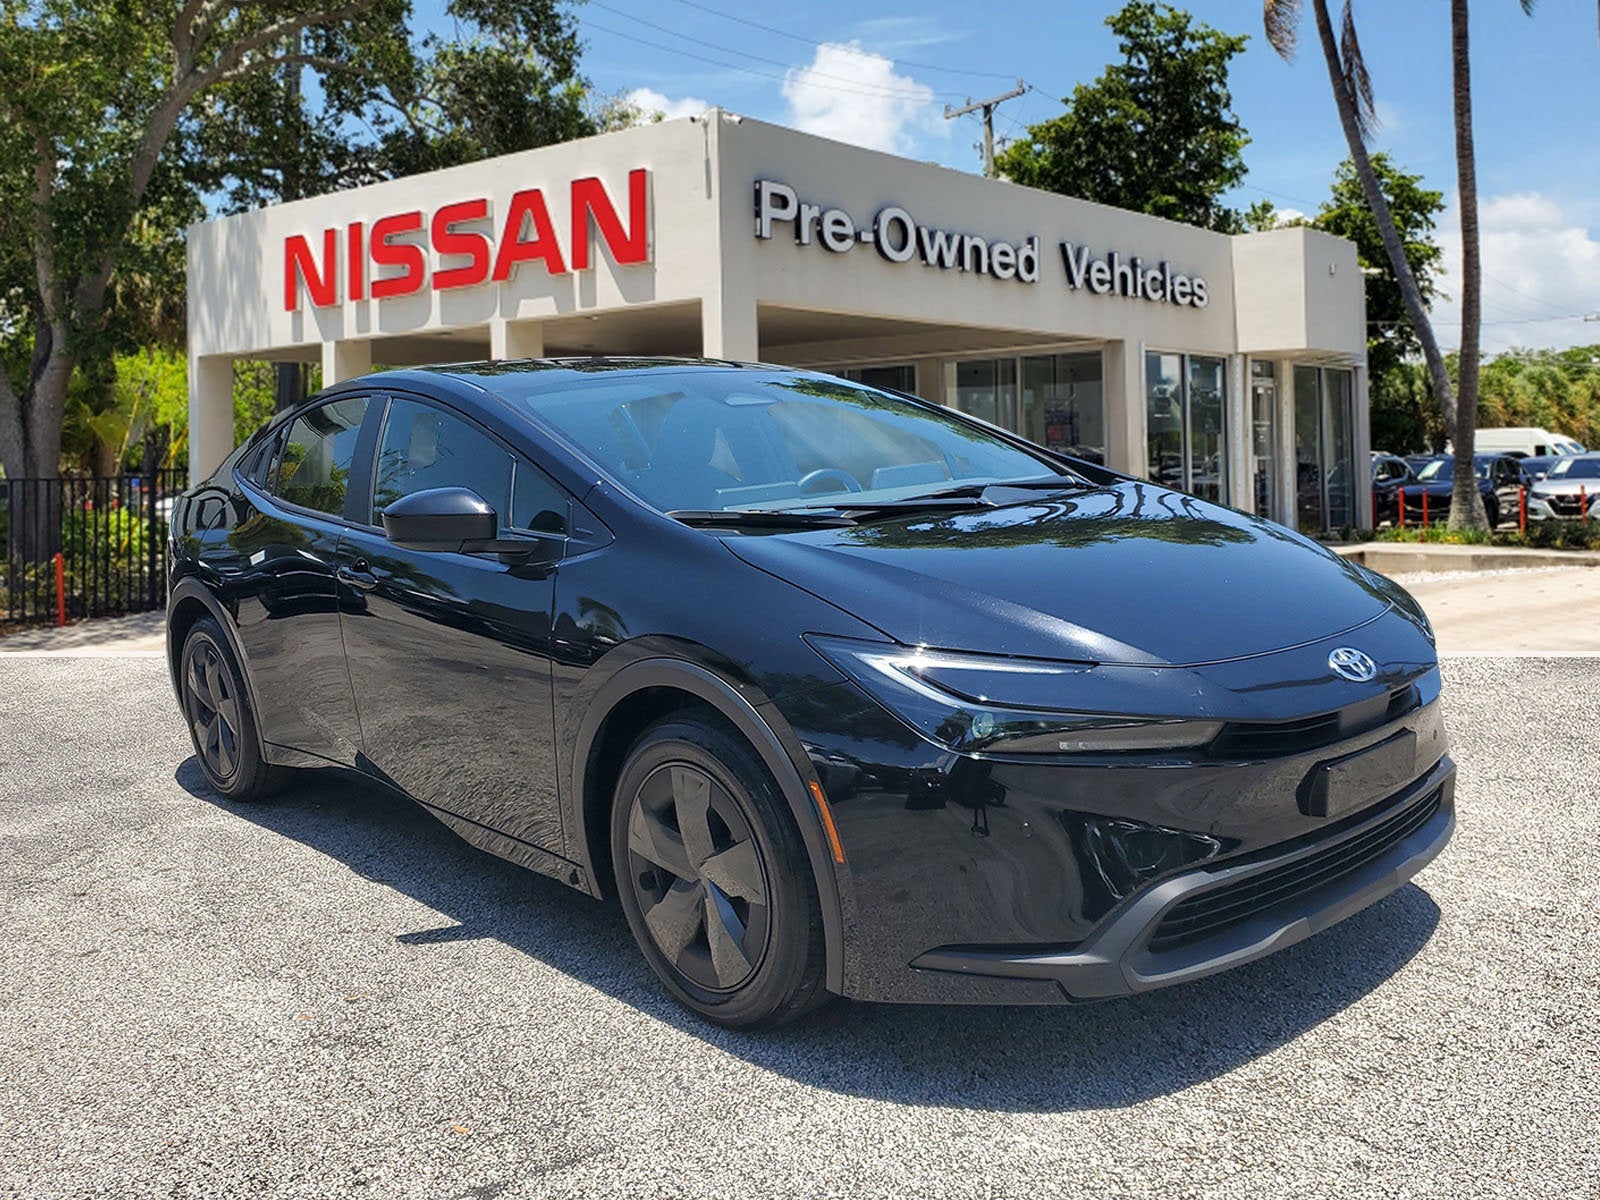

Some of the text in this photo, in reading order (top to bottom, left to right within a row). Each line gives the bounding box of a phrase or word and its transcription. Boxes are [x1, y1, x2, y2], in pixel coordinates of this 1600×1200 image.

[284, 168, 648, 311] NISSAN
[755, 180, 1208, 309] Pre-Owned Vehicles
